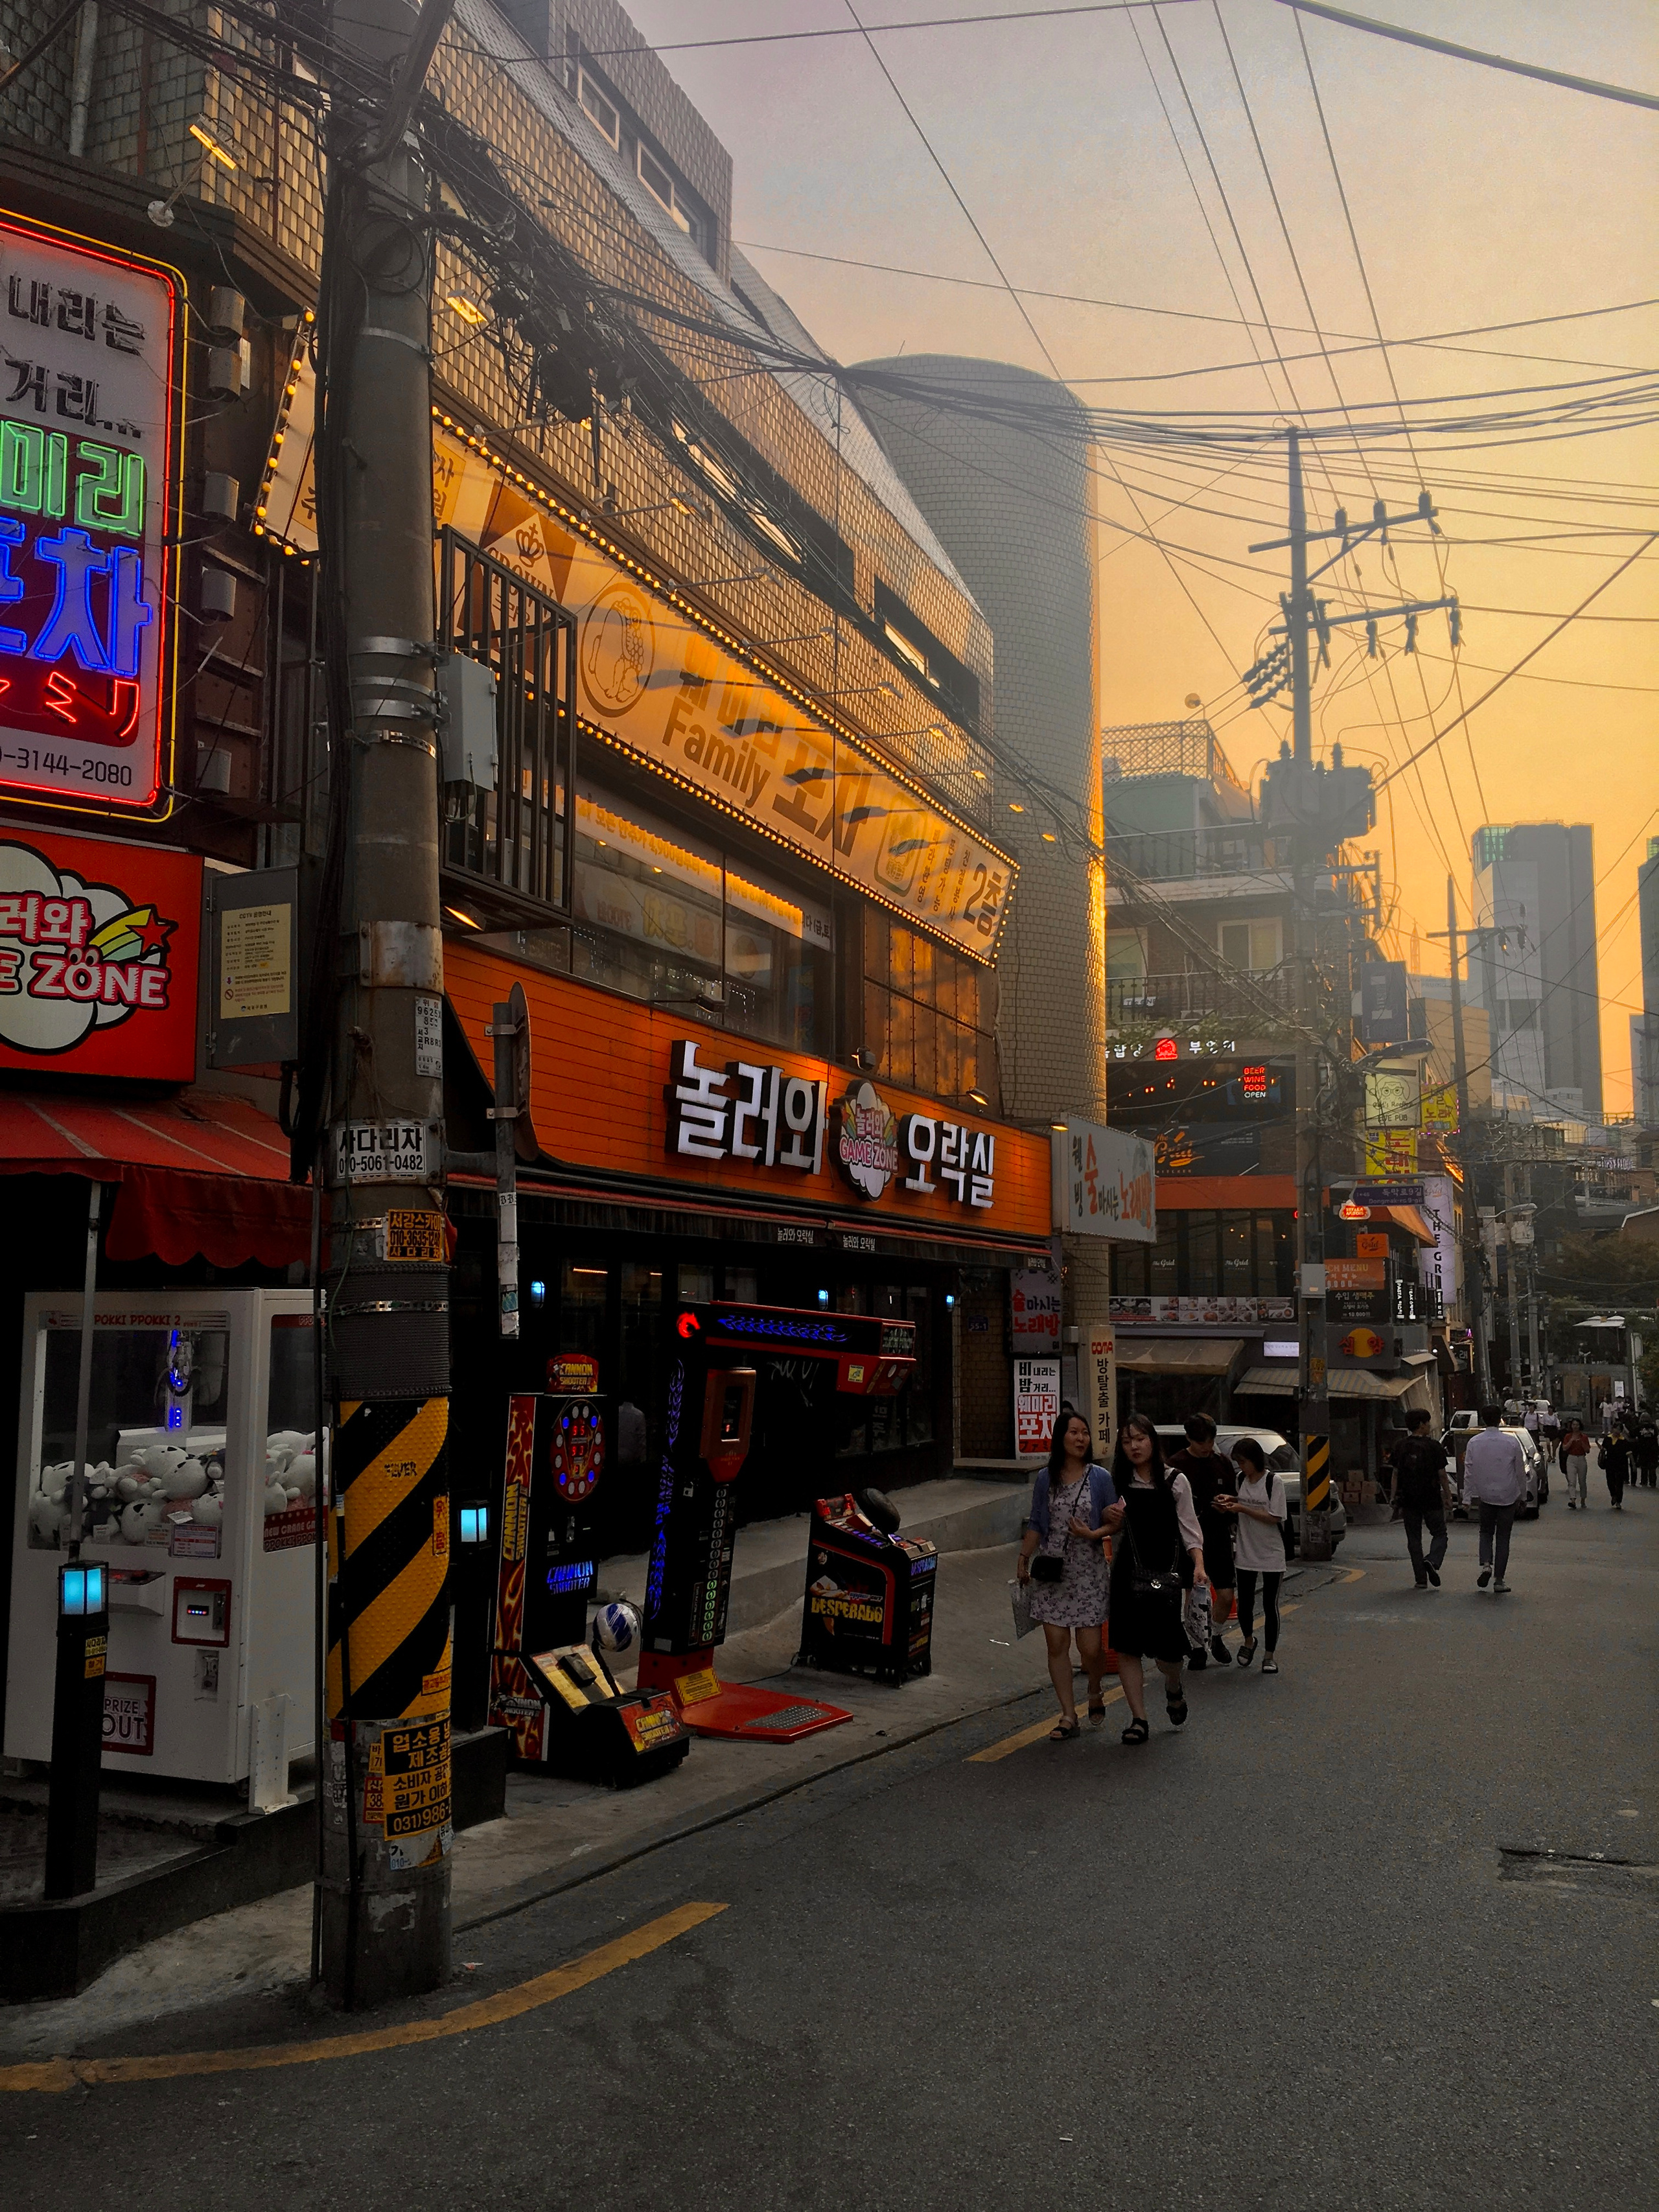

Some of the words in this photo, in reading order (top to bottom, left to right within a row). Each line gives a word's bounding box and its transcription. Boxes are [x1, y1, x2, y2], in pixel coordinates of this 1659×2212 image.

[9, 273, 145, 355] 내리는
[662, 695, 771, 808] Family
[0, 747, 132, 786] -3144-2080
[772, 730, 873, 858] 포차
[963, 863, 1002, 937] 2층
[32, 955, 168, 1006] ZONE
[339, 1128, 422, 1154] 사다리차
[840, 1137, 872, 1165] GAME
[873, 1143, 898, 1170] ZONE
[339, 1154, 423, 1174] 00-5061-0482
[905, 1113, 997, 1209] 오락실
[391, 1213, 441, 1230] 서강스카이
[797, 1229, 814, 1244] 오락실
[860, 1238, 876, 1251] 오락실
[1013, 1288, 1025, 1312] 술
[1027, 1296, 1060, 1312] 마시는
[1335, 1292, 1349, 1300] 수입
[94, 1315, 126, 1325] POKKI
[130, 1315, 170, 1325] PPOKKI
[174, 1315, 180, 1325] 2
[1014, 1313, 1060, 1336] 노래방
[559, 1363, 594, 1376] CANNON
[1019, 1362, 1032, 1376] 비
[1033, 1368, 1056, 1376] 내리는
[1019, 1379, 1033, 1393] 밤
[1097, 1358, 1109, 1408] 방탈출
[1019, 1412, 1057, 1440] 포차
[1098, 1412, 1110, 1443] 카페
[264, 1525, 281, 1538] NEW
[504, 1483, 518, 1561] CANNON
[811, 1597, 883, 1624] DESPERADO
[105, 1698, 139, 1714] PRIZE
[102, 1714, 145, 1740] OUT
[392, 1726, 441, 1753] 업소용
[393, 1771, 430, 1791] 소비자
[395, 1790, 425, 1810] 원가
[429, 1782, 447, 1801] 이하
[393, 1802, 450, 1832] 031)986-
